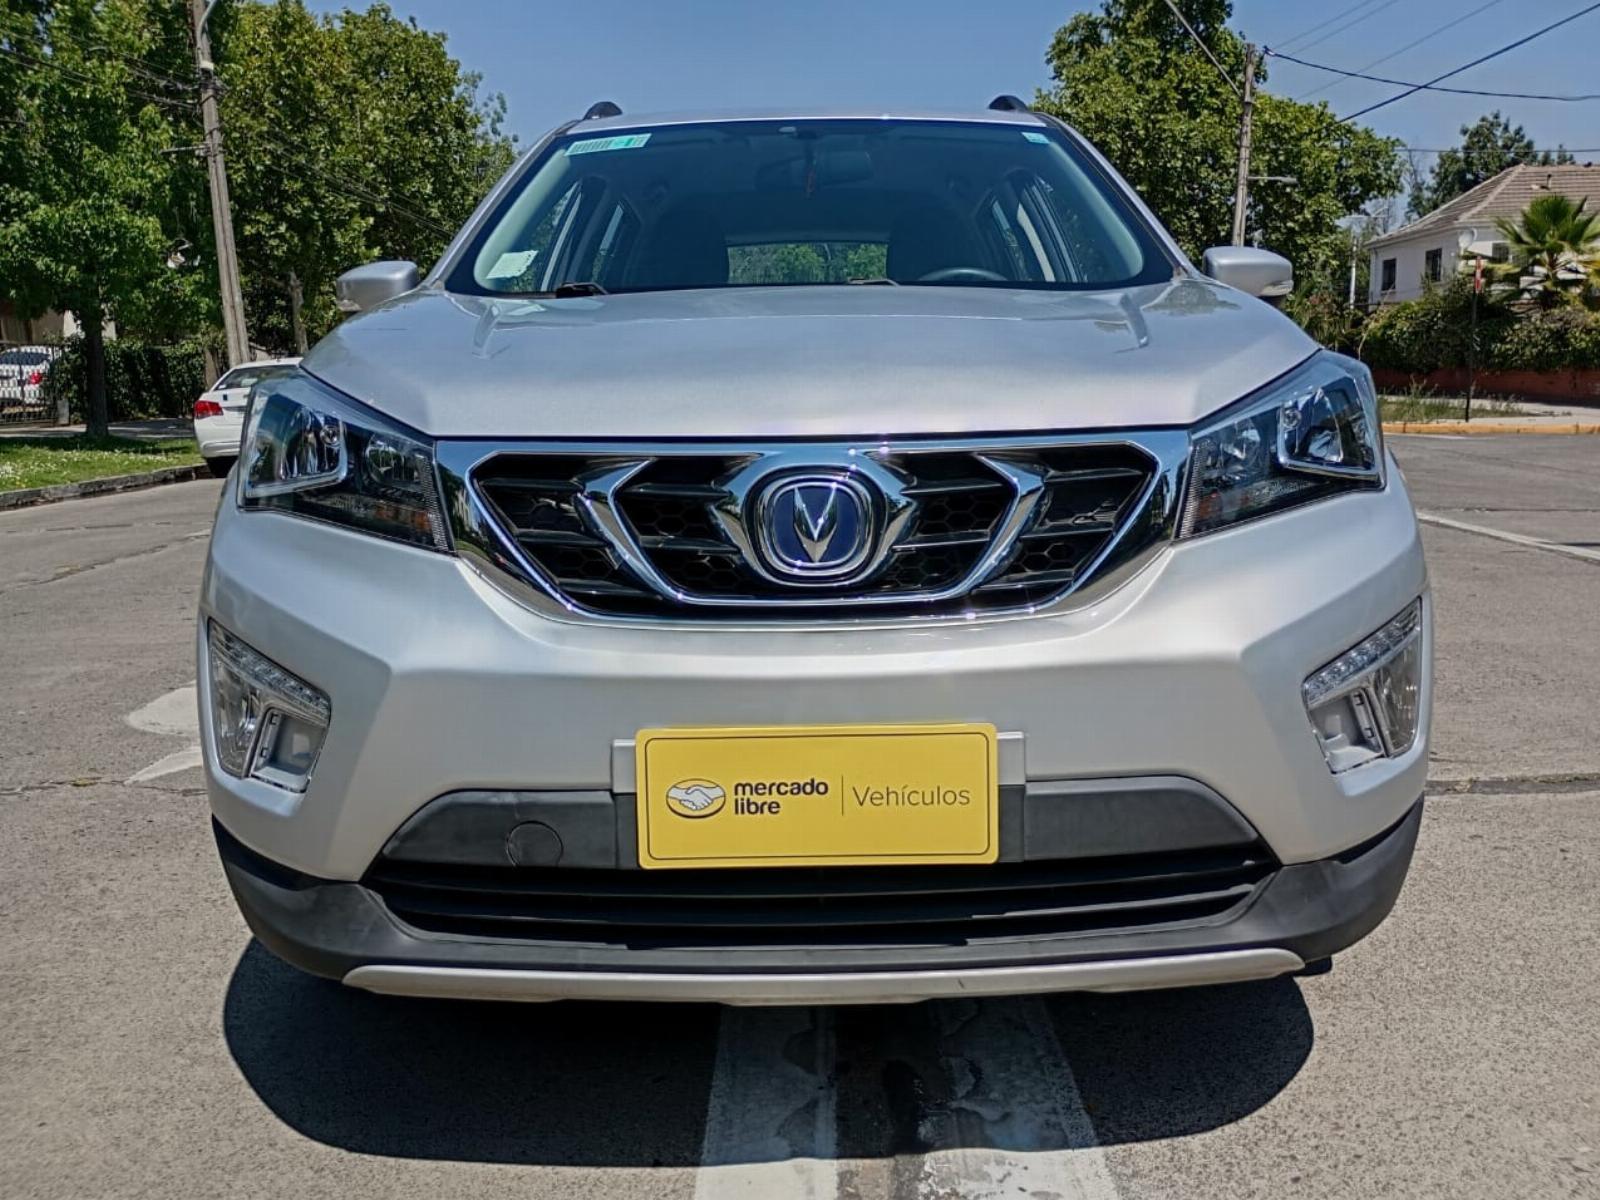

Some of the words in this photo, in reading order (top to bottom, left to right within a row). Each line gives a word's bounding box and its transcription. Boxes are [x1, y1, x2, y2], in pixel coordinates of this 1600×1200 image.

[734, 778, 829, 798] mercado
[852, 785, 971, 808] Vehículos
[734, 798, 781, 816] libre
